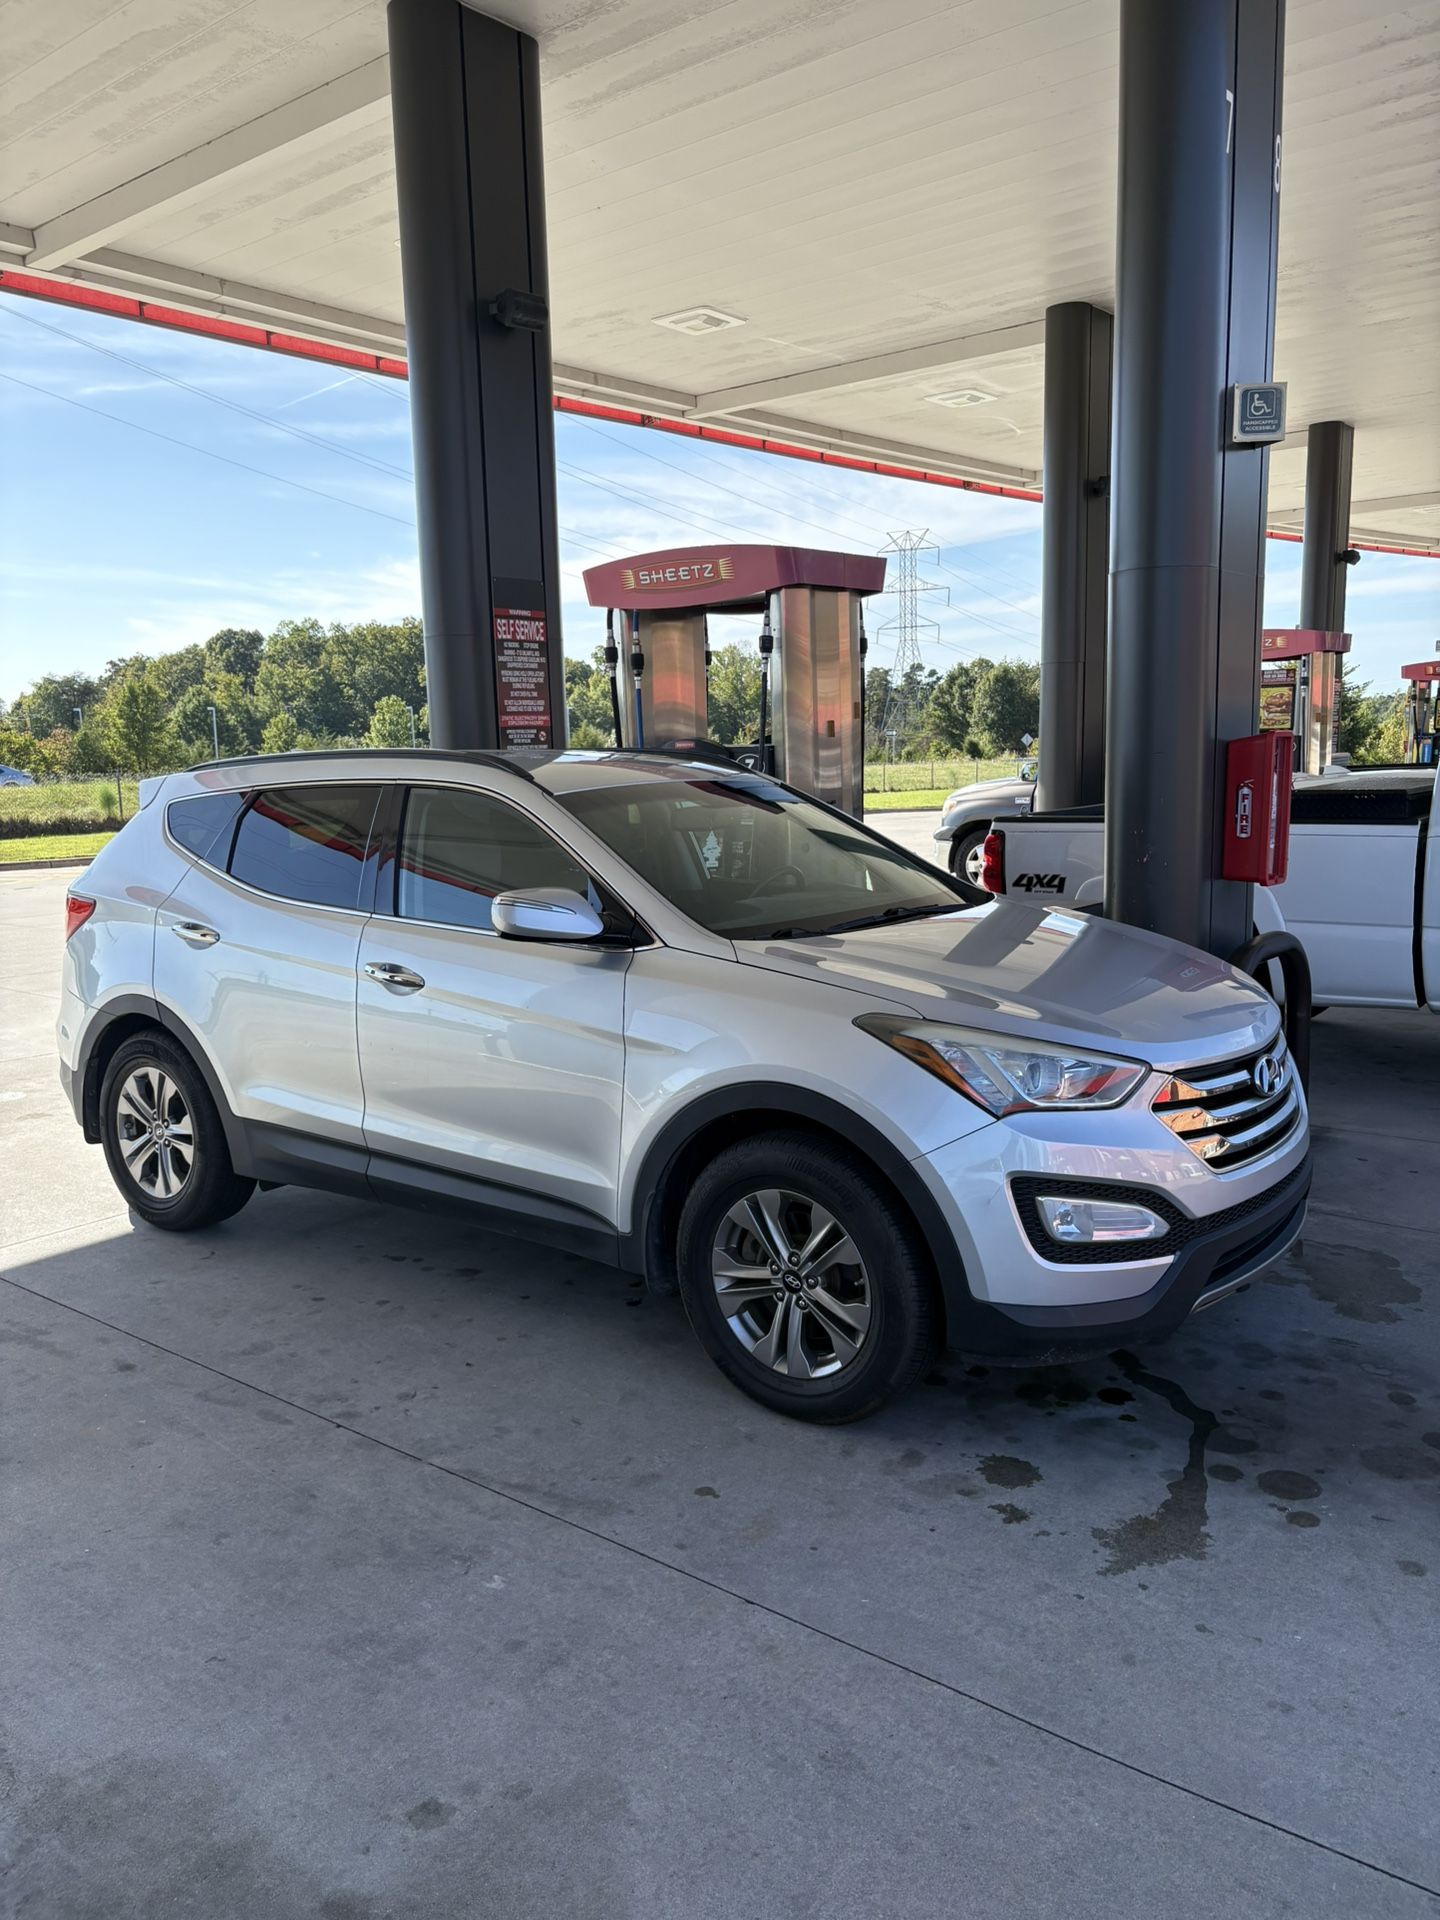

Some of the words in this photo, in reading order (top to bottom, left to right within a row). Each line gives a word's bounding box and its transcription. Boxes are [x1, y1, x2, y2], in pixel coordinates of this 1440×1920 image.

[1226, 89, 1234, 154] 7
[1274, 134, 1281, 193] 8
[639, 563, 714, 585] SHEETZ
[497, 618, 514, 639] SELF
[515, 620, 545, 642] SERVICE
[745, 759, 755, 769] 7
[1240, 794, 1249, 834] FIRE
